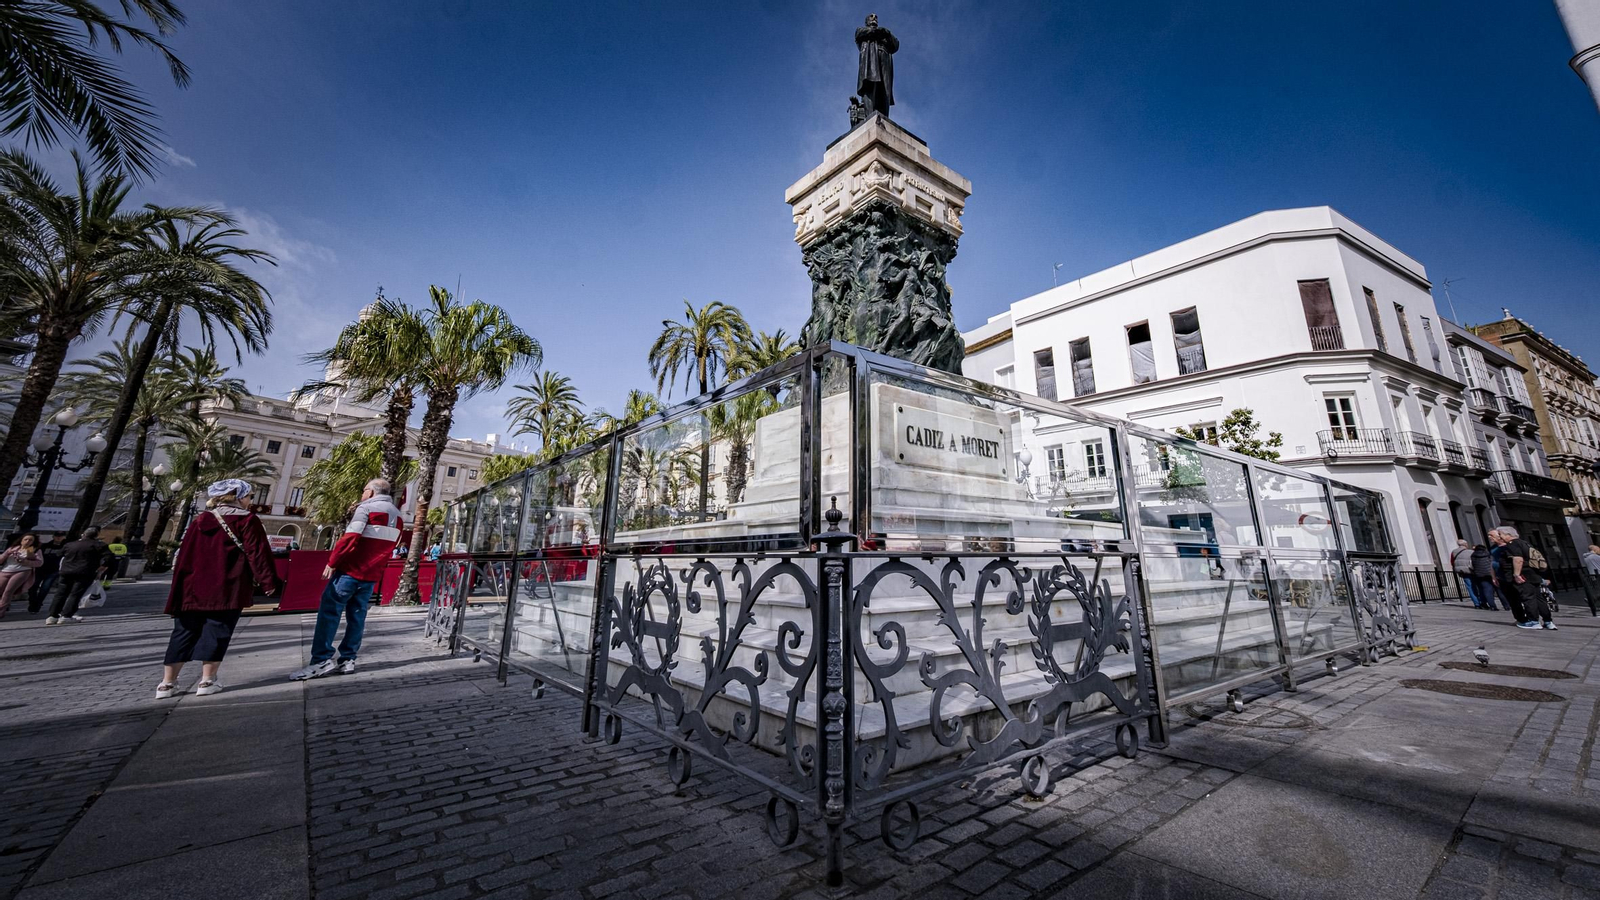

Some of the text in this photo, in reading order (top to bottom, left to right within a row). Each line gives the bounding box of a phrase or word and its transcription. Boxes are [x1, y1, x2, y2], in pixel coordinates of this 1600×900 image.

[906, 425, 999, 459] CADIZ A MORET
